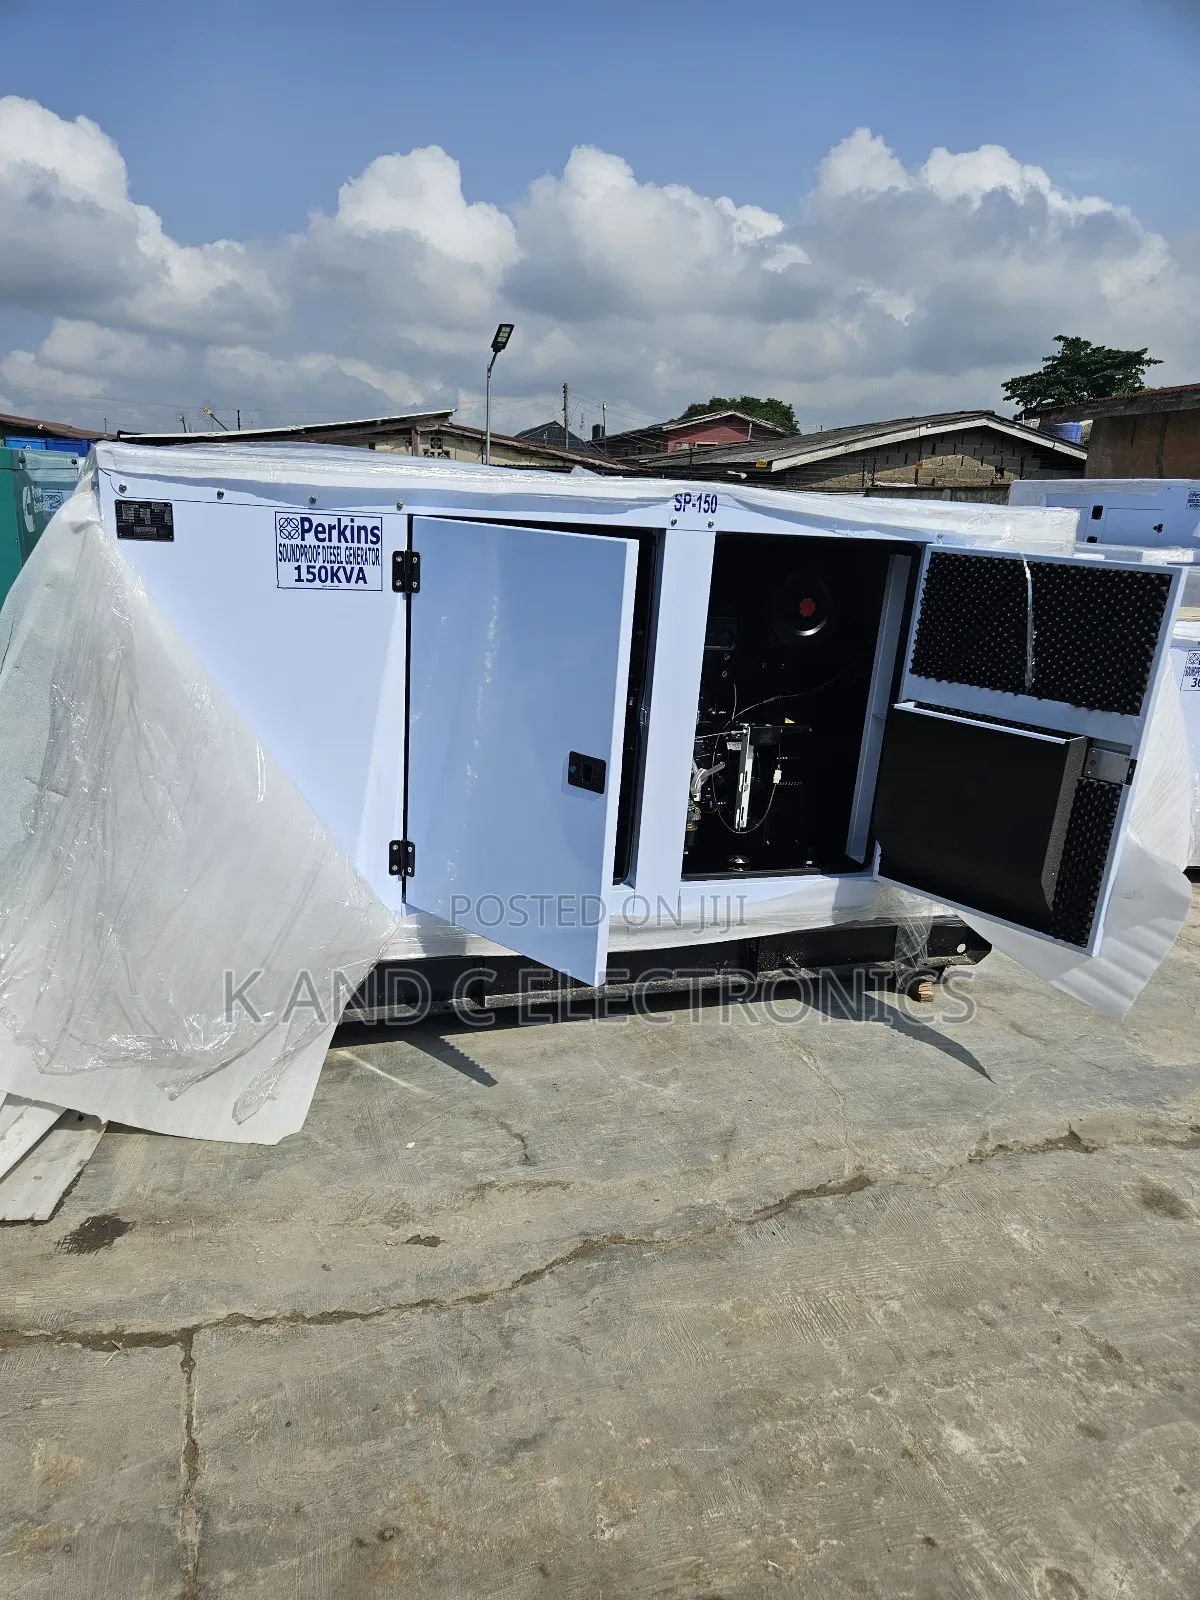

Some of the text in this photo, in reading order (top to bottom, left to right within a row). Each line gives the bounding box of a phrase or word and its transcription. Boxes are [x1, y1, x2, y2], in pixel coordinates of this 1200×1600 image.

[674, 491, 718, 514] SP-150
[299, 516, 381, 545] Perkins
[278, 542, 381, 567] SOUNDPROOF DIESEL GENERATOR
[293, 564, 368, 585] 150KVA
